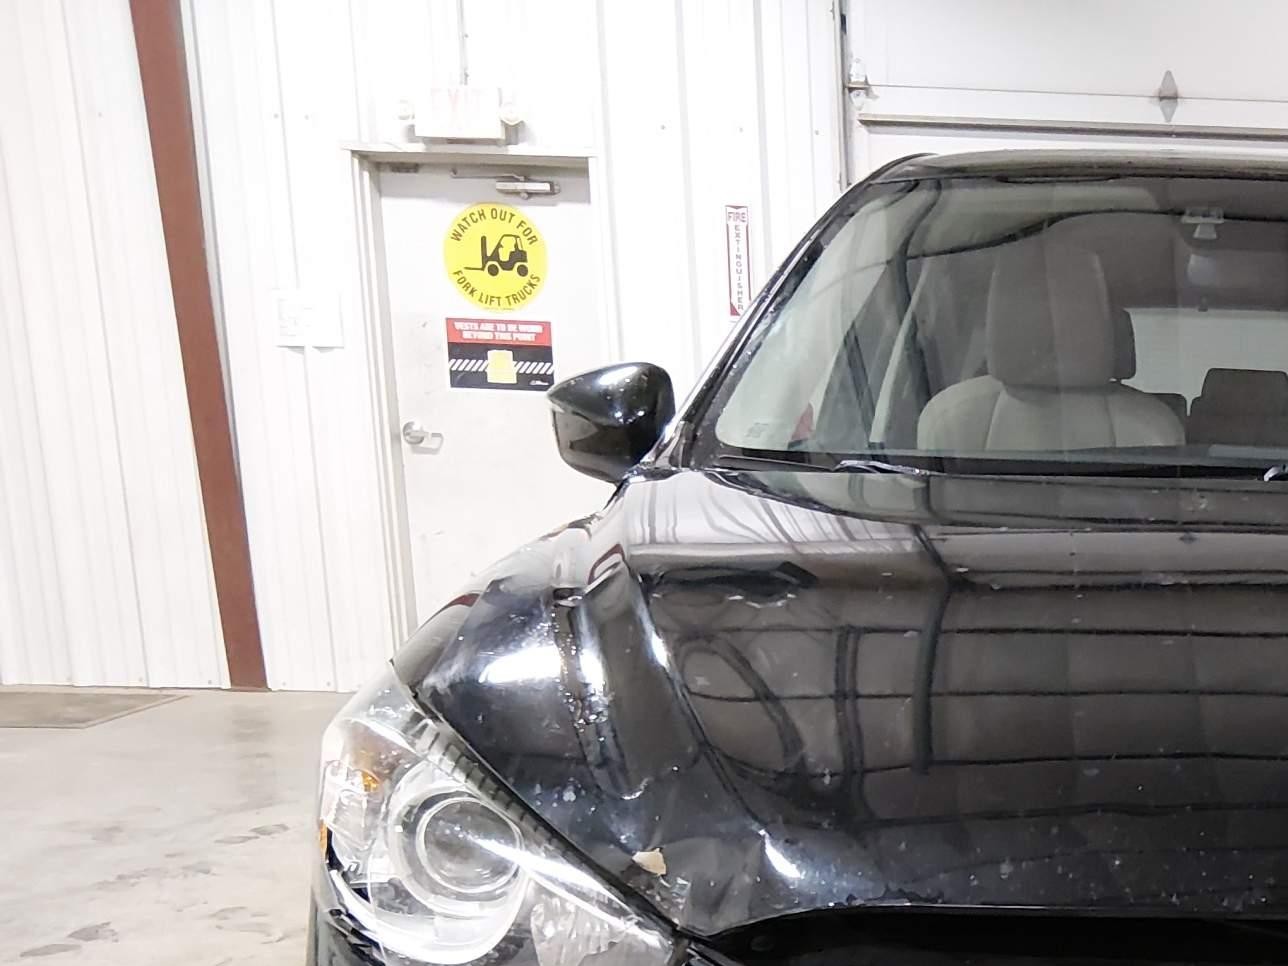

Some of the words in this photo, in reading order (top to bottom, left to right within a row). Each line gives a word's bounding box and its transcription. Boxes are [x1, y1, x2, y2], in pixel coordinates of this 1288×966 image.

[450, 208, 487, 242] WATCH
[490, 207, 516, 224] OUT
[516, 219, 539, 246] FOR
[727, 211, 747, 223] FIRE
[734, 224, 744, 311] EXTINGUISHER
[452, 269, 477, 298] FORK
[477, 291, 502, 307] LIFT
[504, 273, 541, 307] TRUCKS
